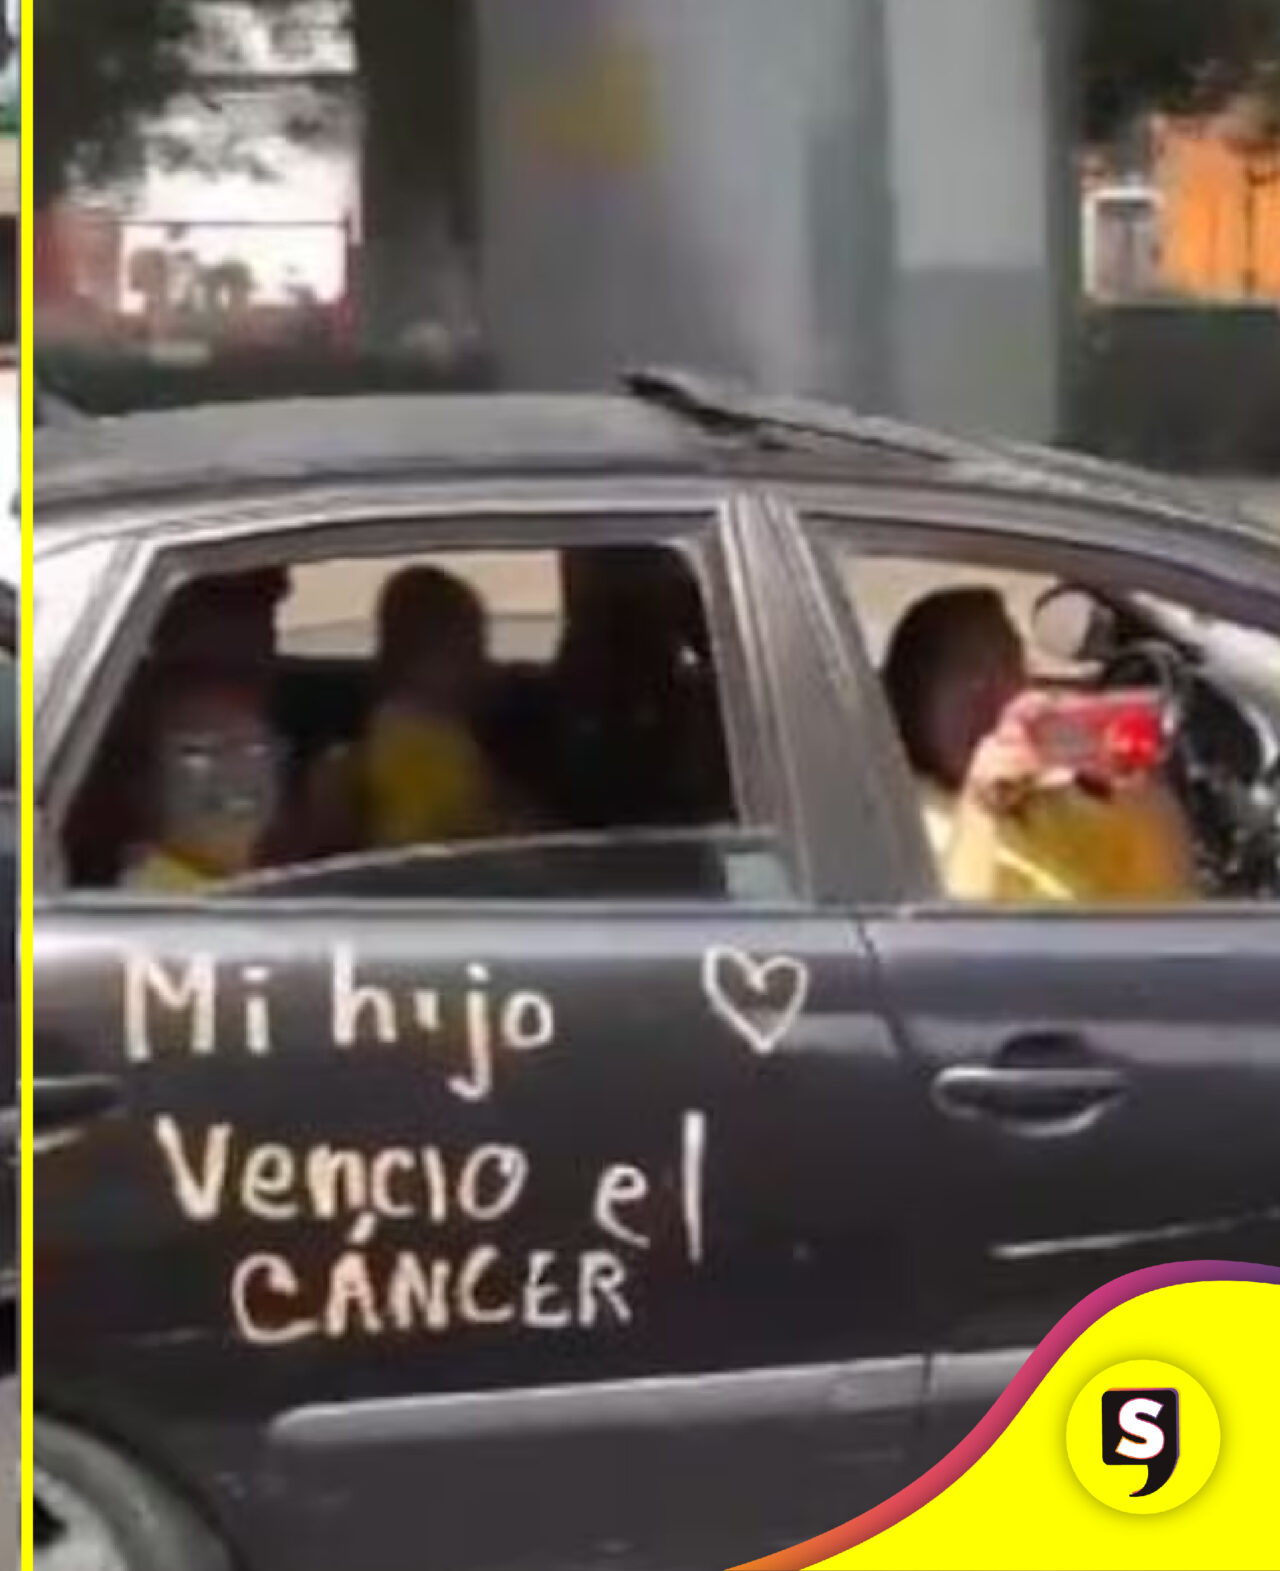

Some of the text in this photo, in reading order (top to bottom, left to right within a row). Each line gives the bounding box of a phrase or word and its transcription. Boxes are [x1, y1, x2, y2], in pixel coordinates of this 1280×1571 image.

[123, 942, 556, 1099] Mi hijo
[592, 1110, 706, 1264] el
[231, 1212, 632, 1344] CÁNCER
